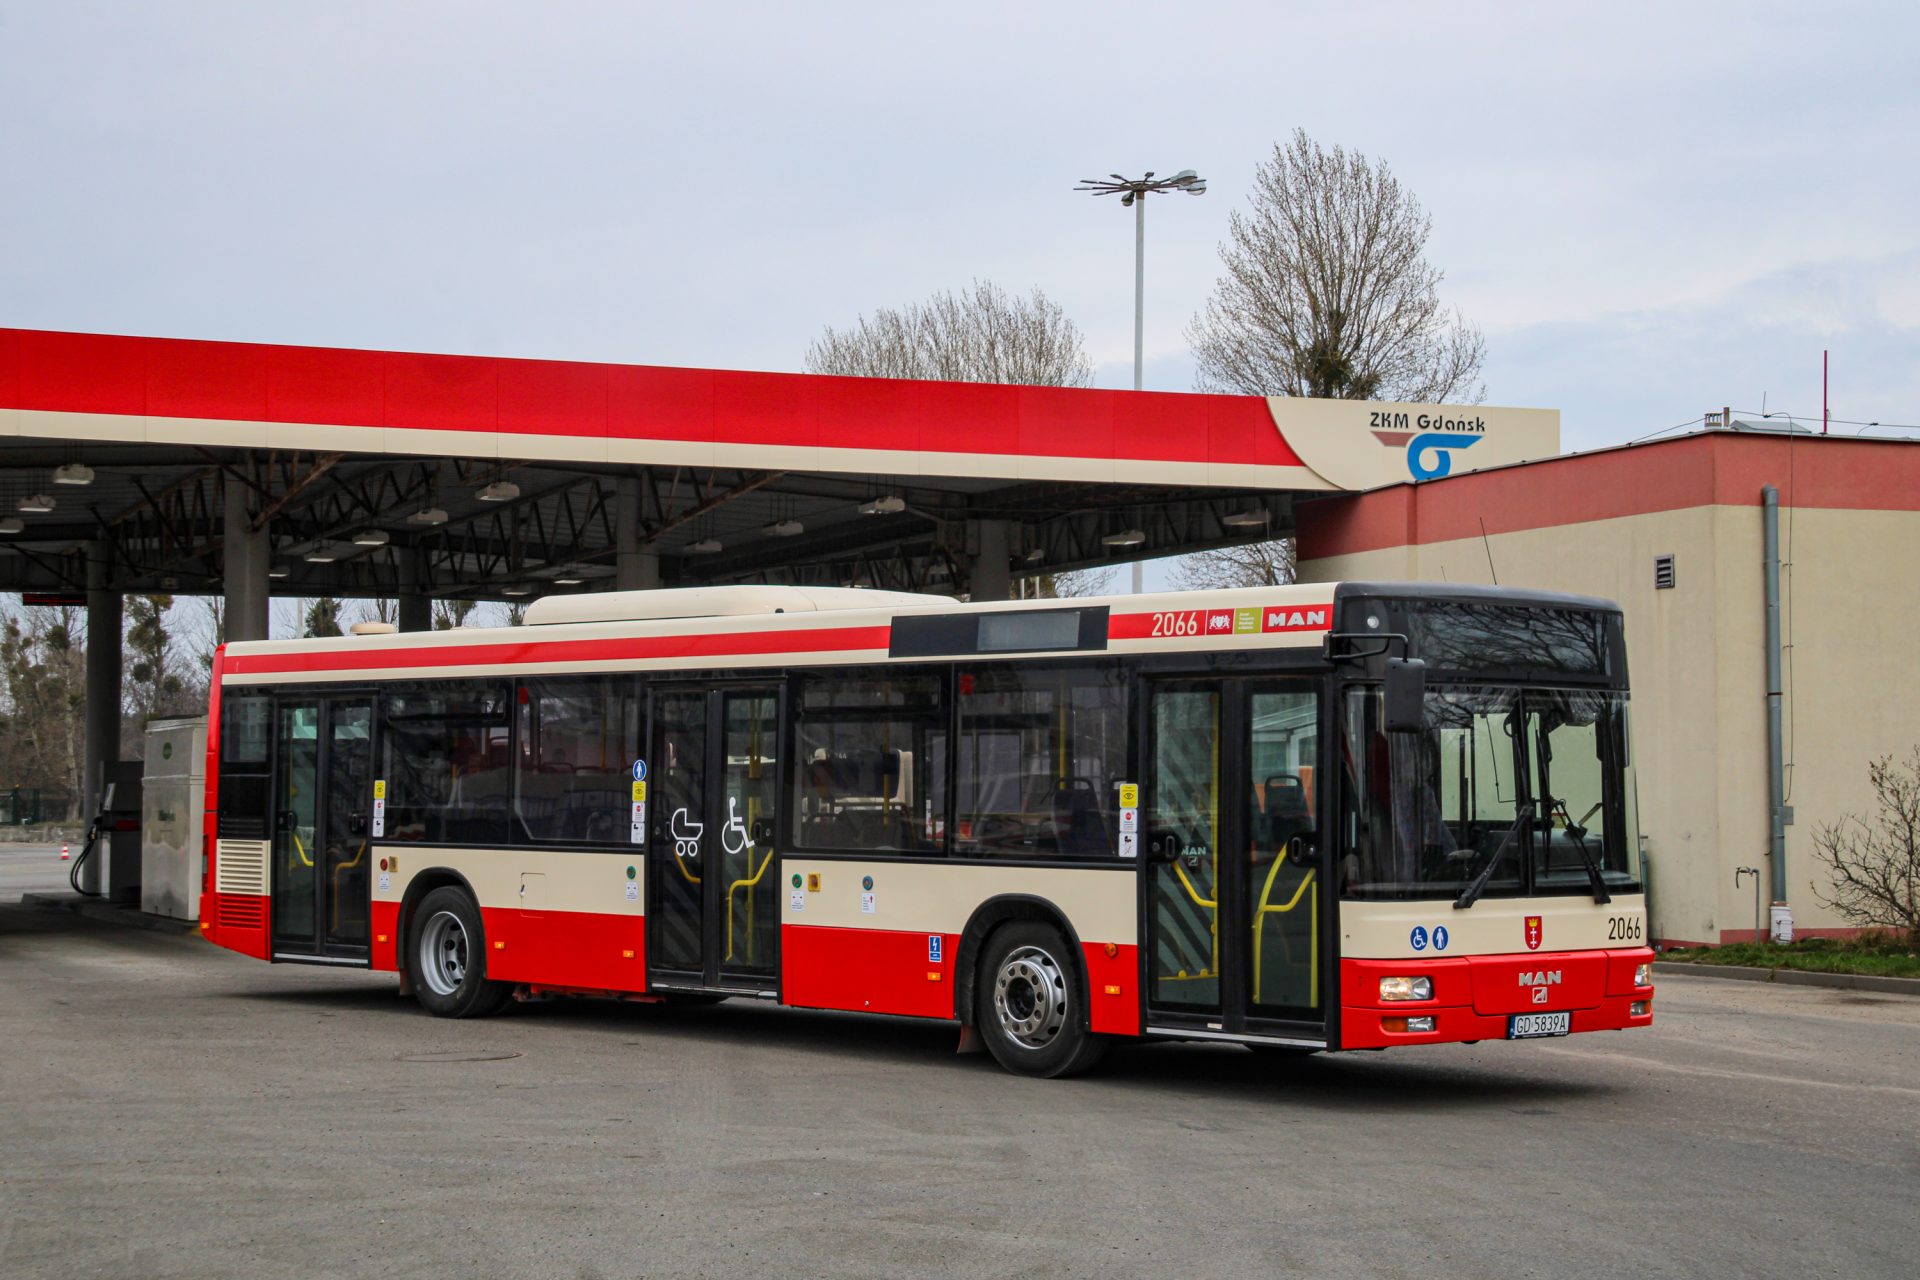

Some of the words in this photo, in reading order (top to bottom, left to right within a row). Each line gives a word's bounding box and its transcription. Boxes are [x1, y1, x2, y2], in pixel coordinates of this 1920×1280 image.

[1370, 412, 1409, 429] ZKM
[1417, 414, 1485, 432] Gdańsk
[1151, 612, 1198, 637] 2066
[1268, 611, 1325, 627] MAN
[1608, 917, 1641, 940] 2066
[1518, 970, 1562, 987] MAN
[1516, 1017, 1531, 1033] GD
[1534, 1015, 1566, 1032] 5839A
